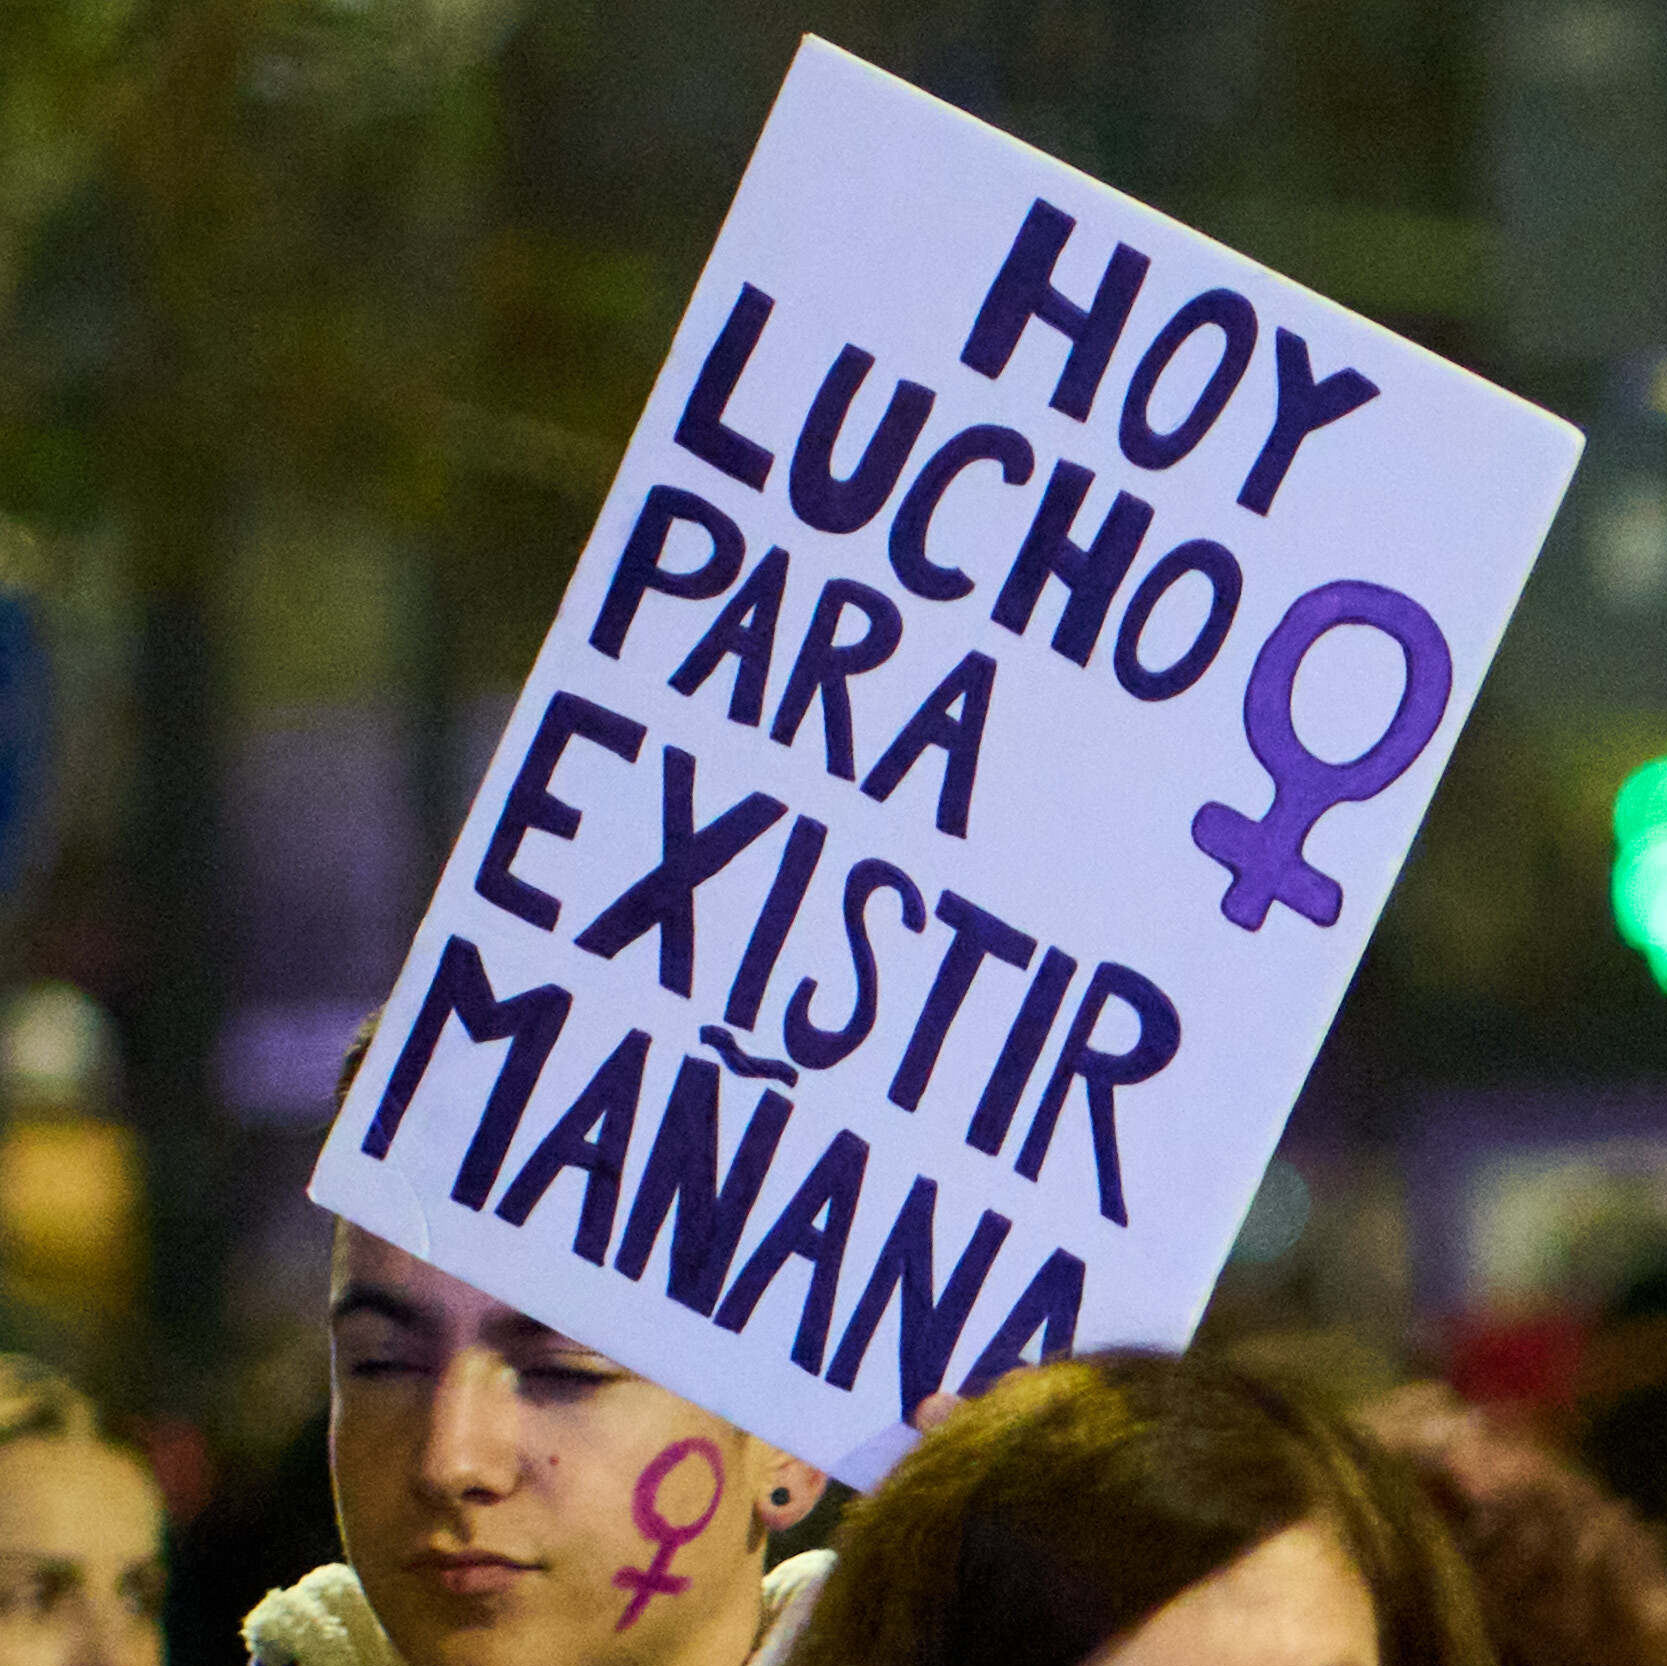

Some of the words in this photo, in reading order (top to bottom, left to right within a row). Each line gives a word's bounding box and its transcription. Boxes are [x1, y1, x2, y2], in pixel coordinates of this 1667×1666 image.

[674, 282, 1243, 702] LUCHO
[960, 198, 1380, 516] HOY
[589, 485, 997, 839] PARA
[475, 691, 1181, 1227] EXISTIR
[361, 934, 1085, 1425] MAÑANA
